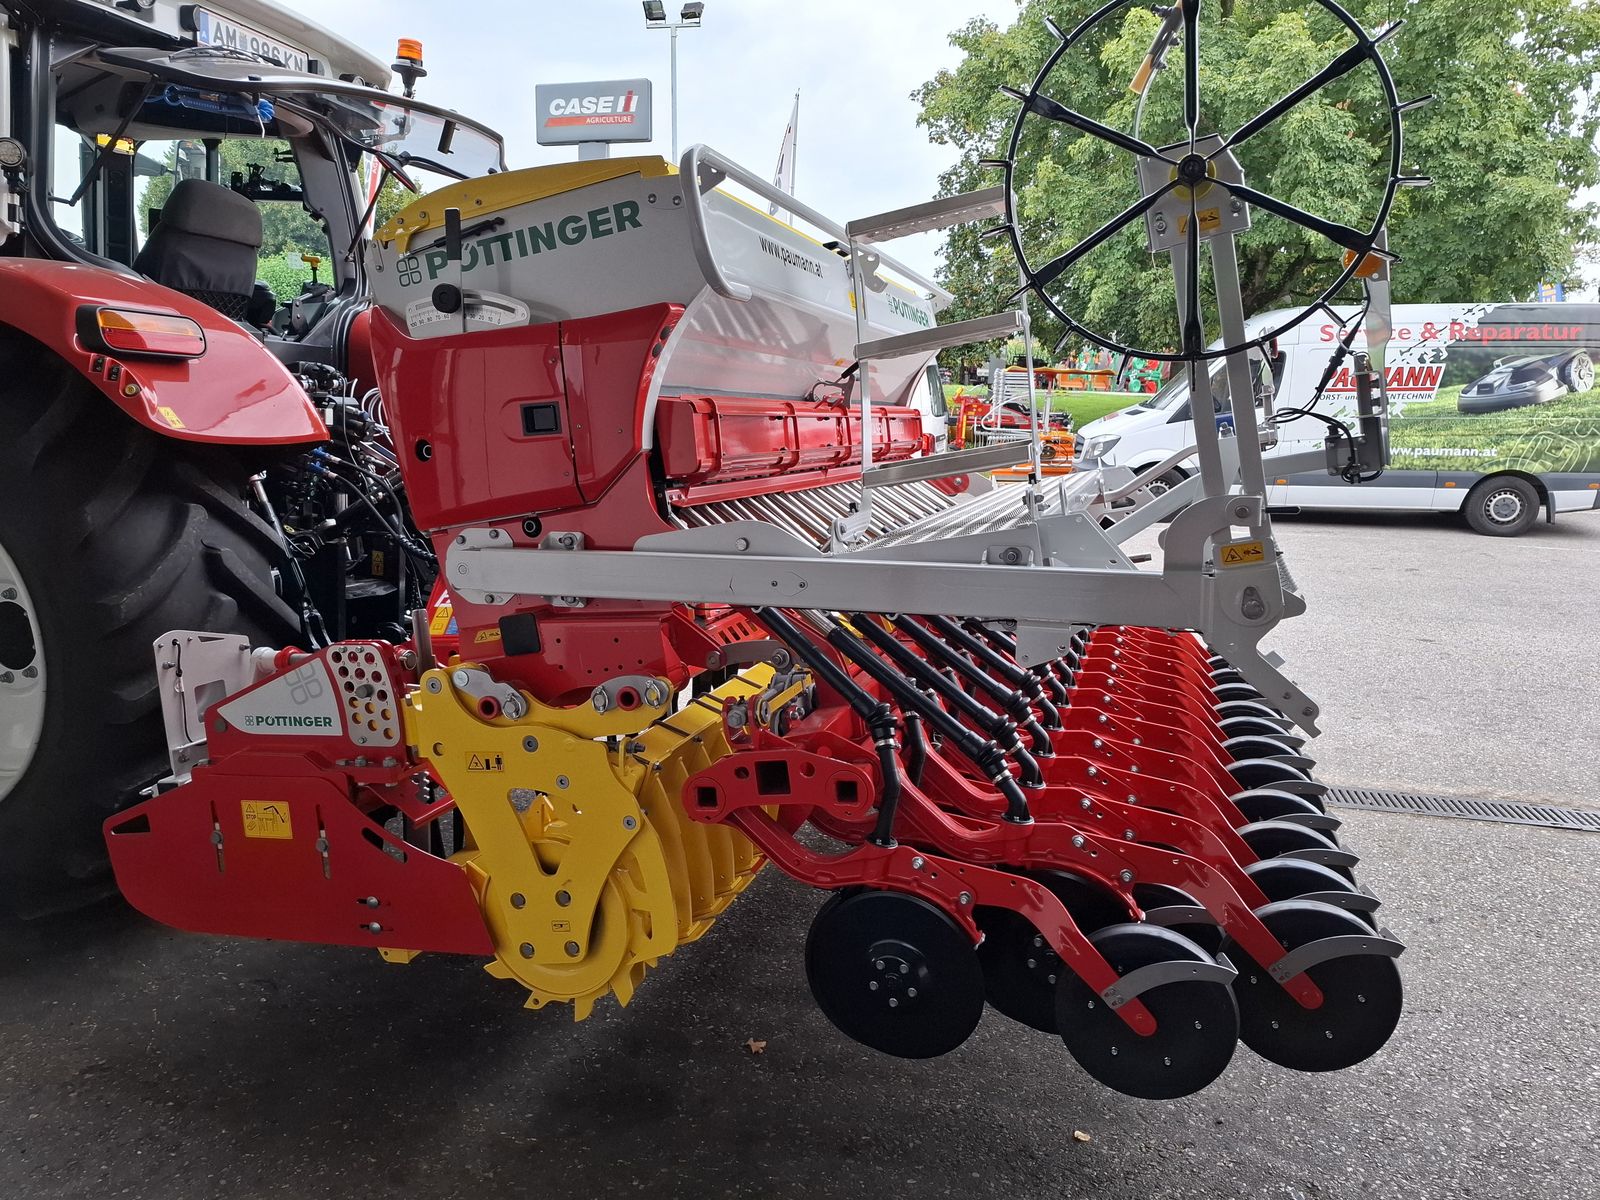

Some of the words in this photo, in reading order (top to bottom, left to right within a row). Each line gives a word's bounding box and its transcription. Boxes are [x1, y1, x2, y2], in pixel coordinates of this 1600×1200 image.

[213, 21, 236, 49] AM
[284, 50, 303, 72] KN
[549, 96, 614, 116] CASE
[586, 115, 632, 125] AGRICULTURE
[759, 236, 823, 279] www.paumann.at
[1421, 322, 1439, 340] &
[1450, 322, 1586, 345] Reparatur
[256, 715, 333, 728] PÖTTINGER
